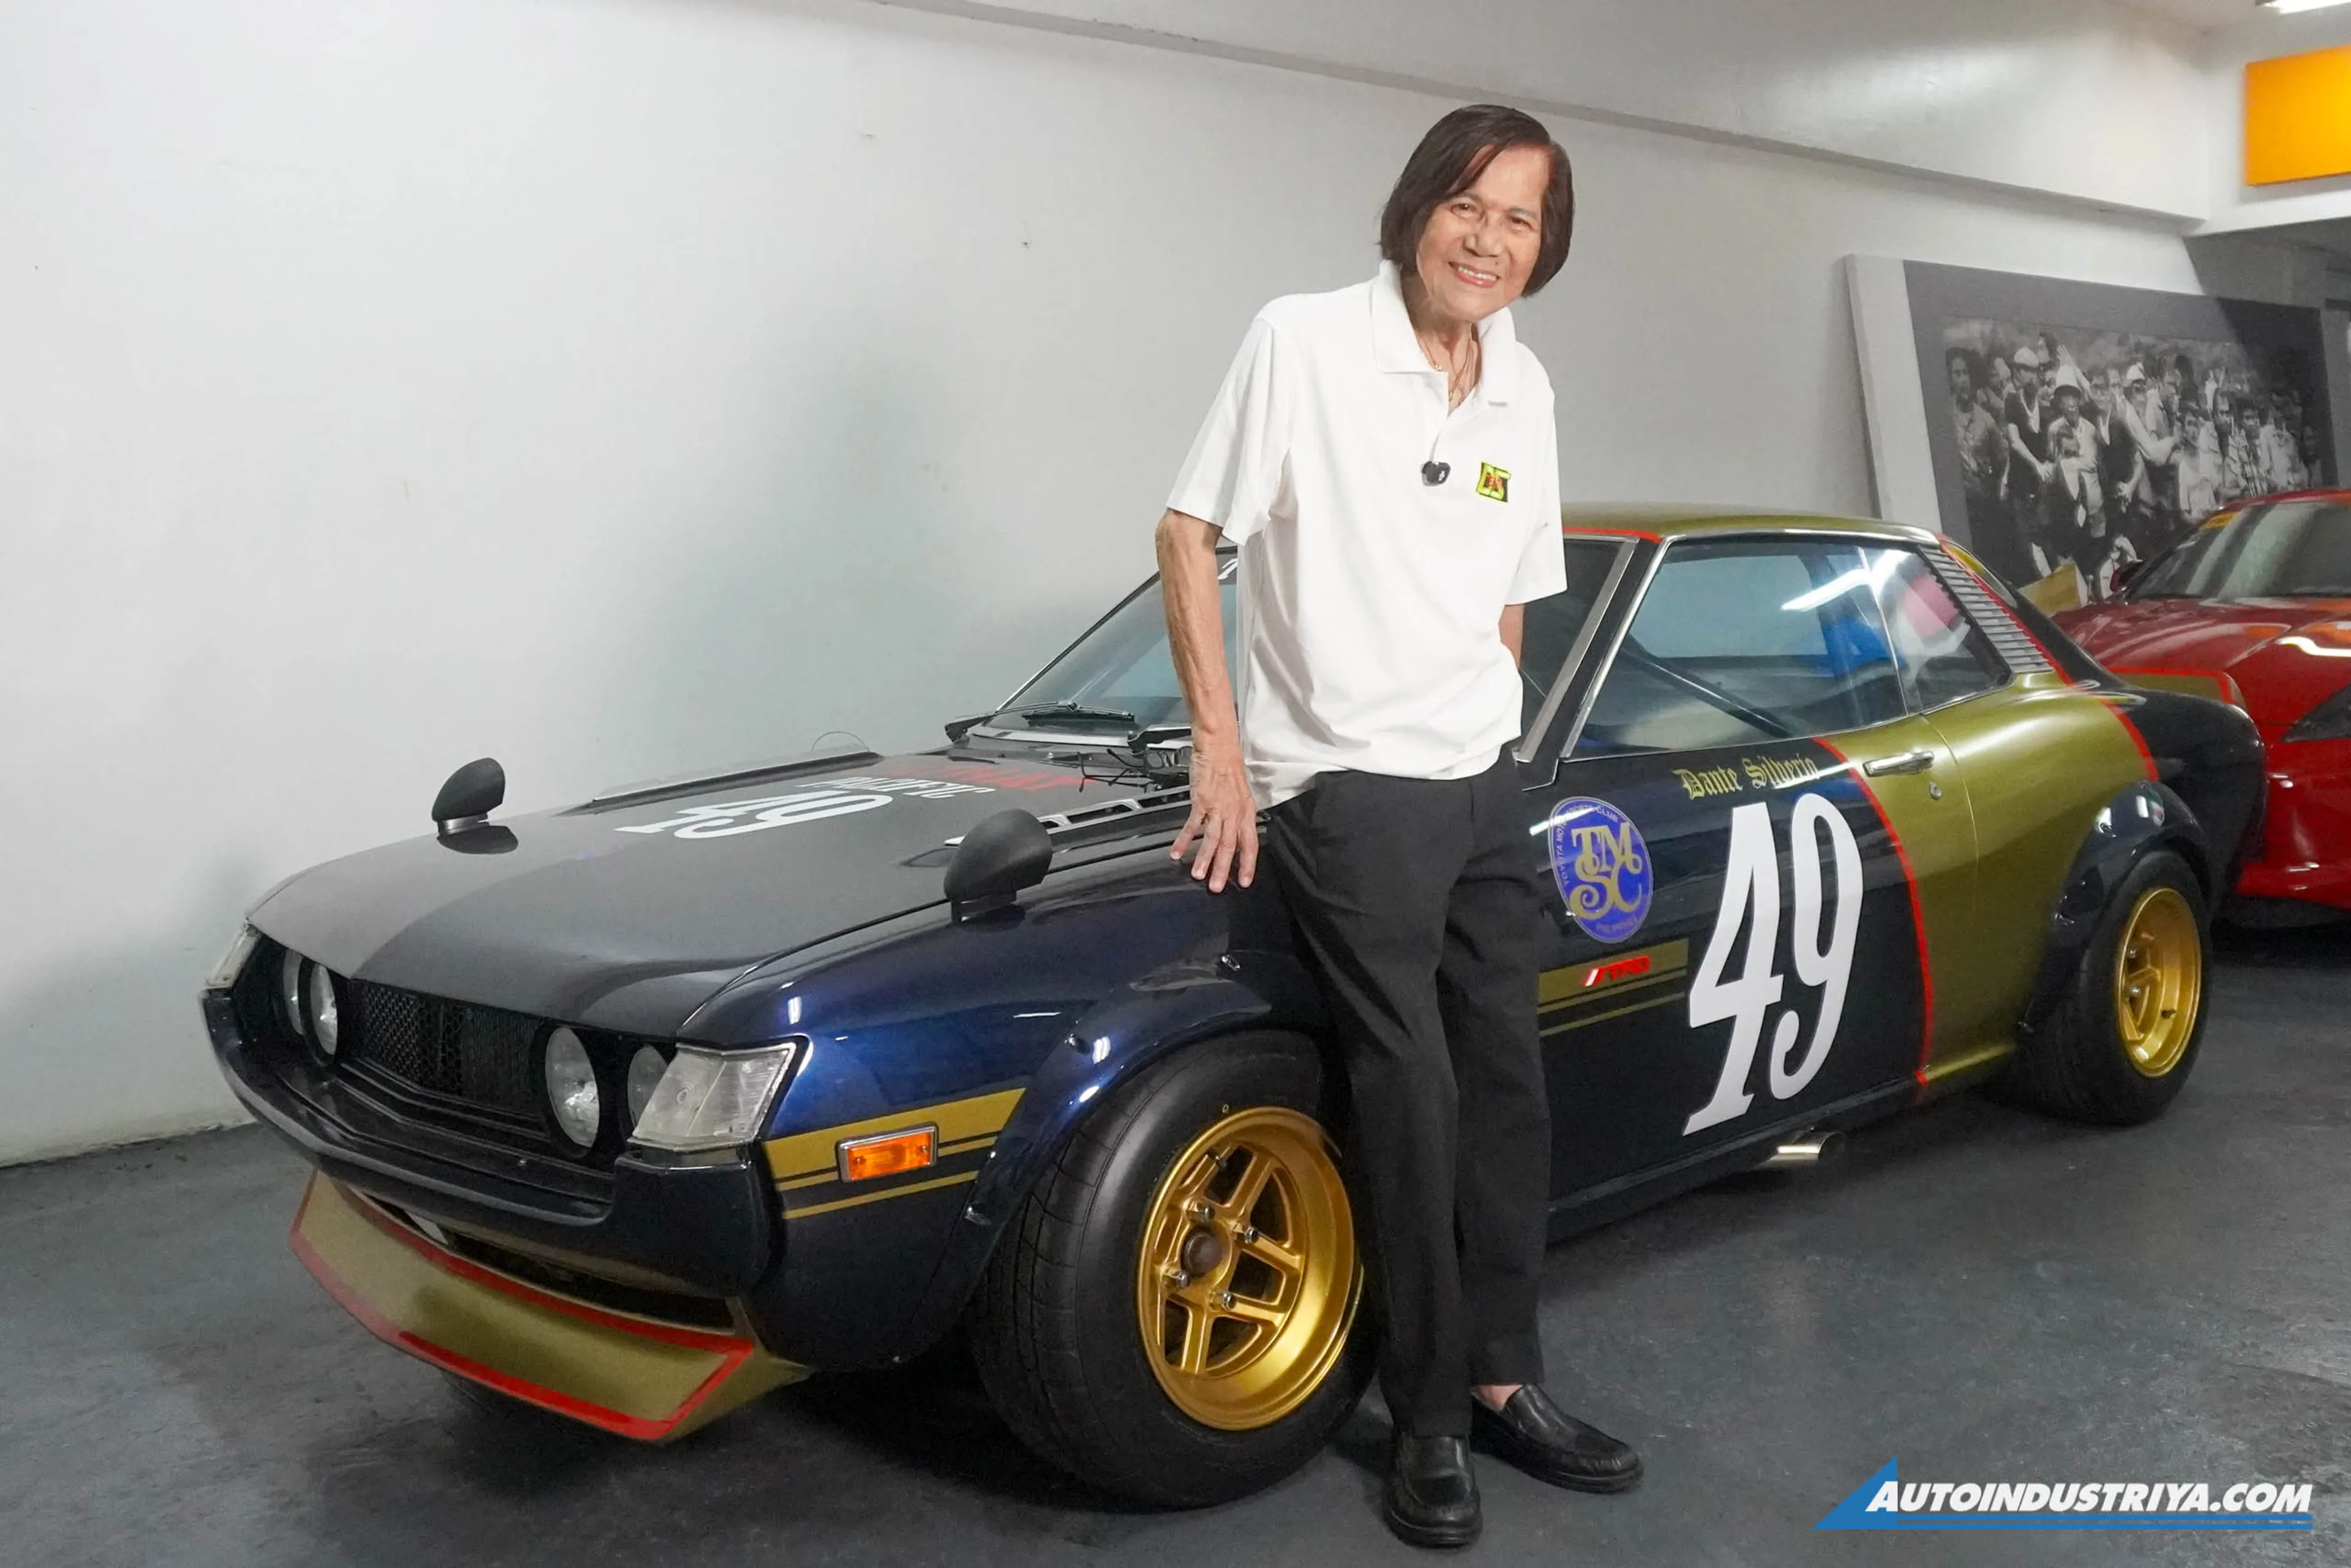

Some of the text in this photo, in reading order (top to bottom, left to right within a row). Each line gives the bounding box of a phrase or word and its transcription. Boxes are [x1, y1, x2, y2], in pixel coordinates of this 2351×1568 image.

[1672, 765, 1744, 800] Dante
[613, 790, 894, 839] 49
[1598, 955, 1650, 981] TRD
[1682, 793, 1863, 1136] 49
